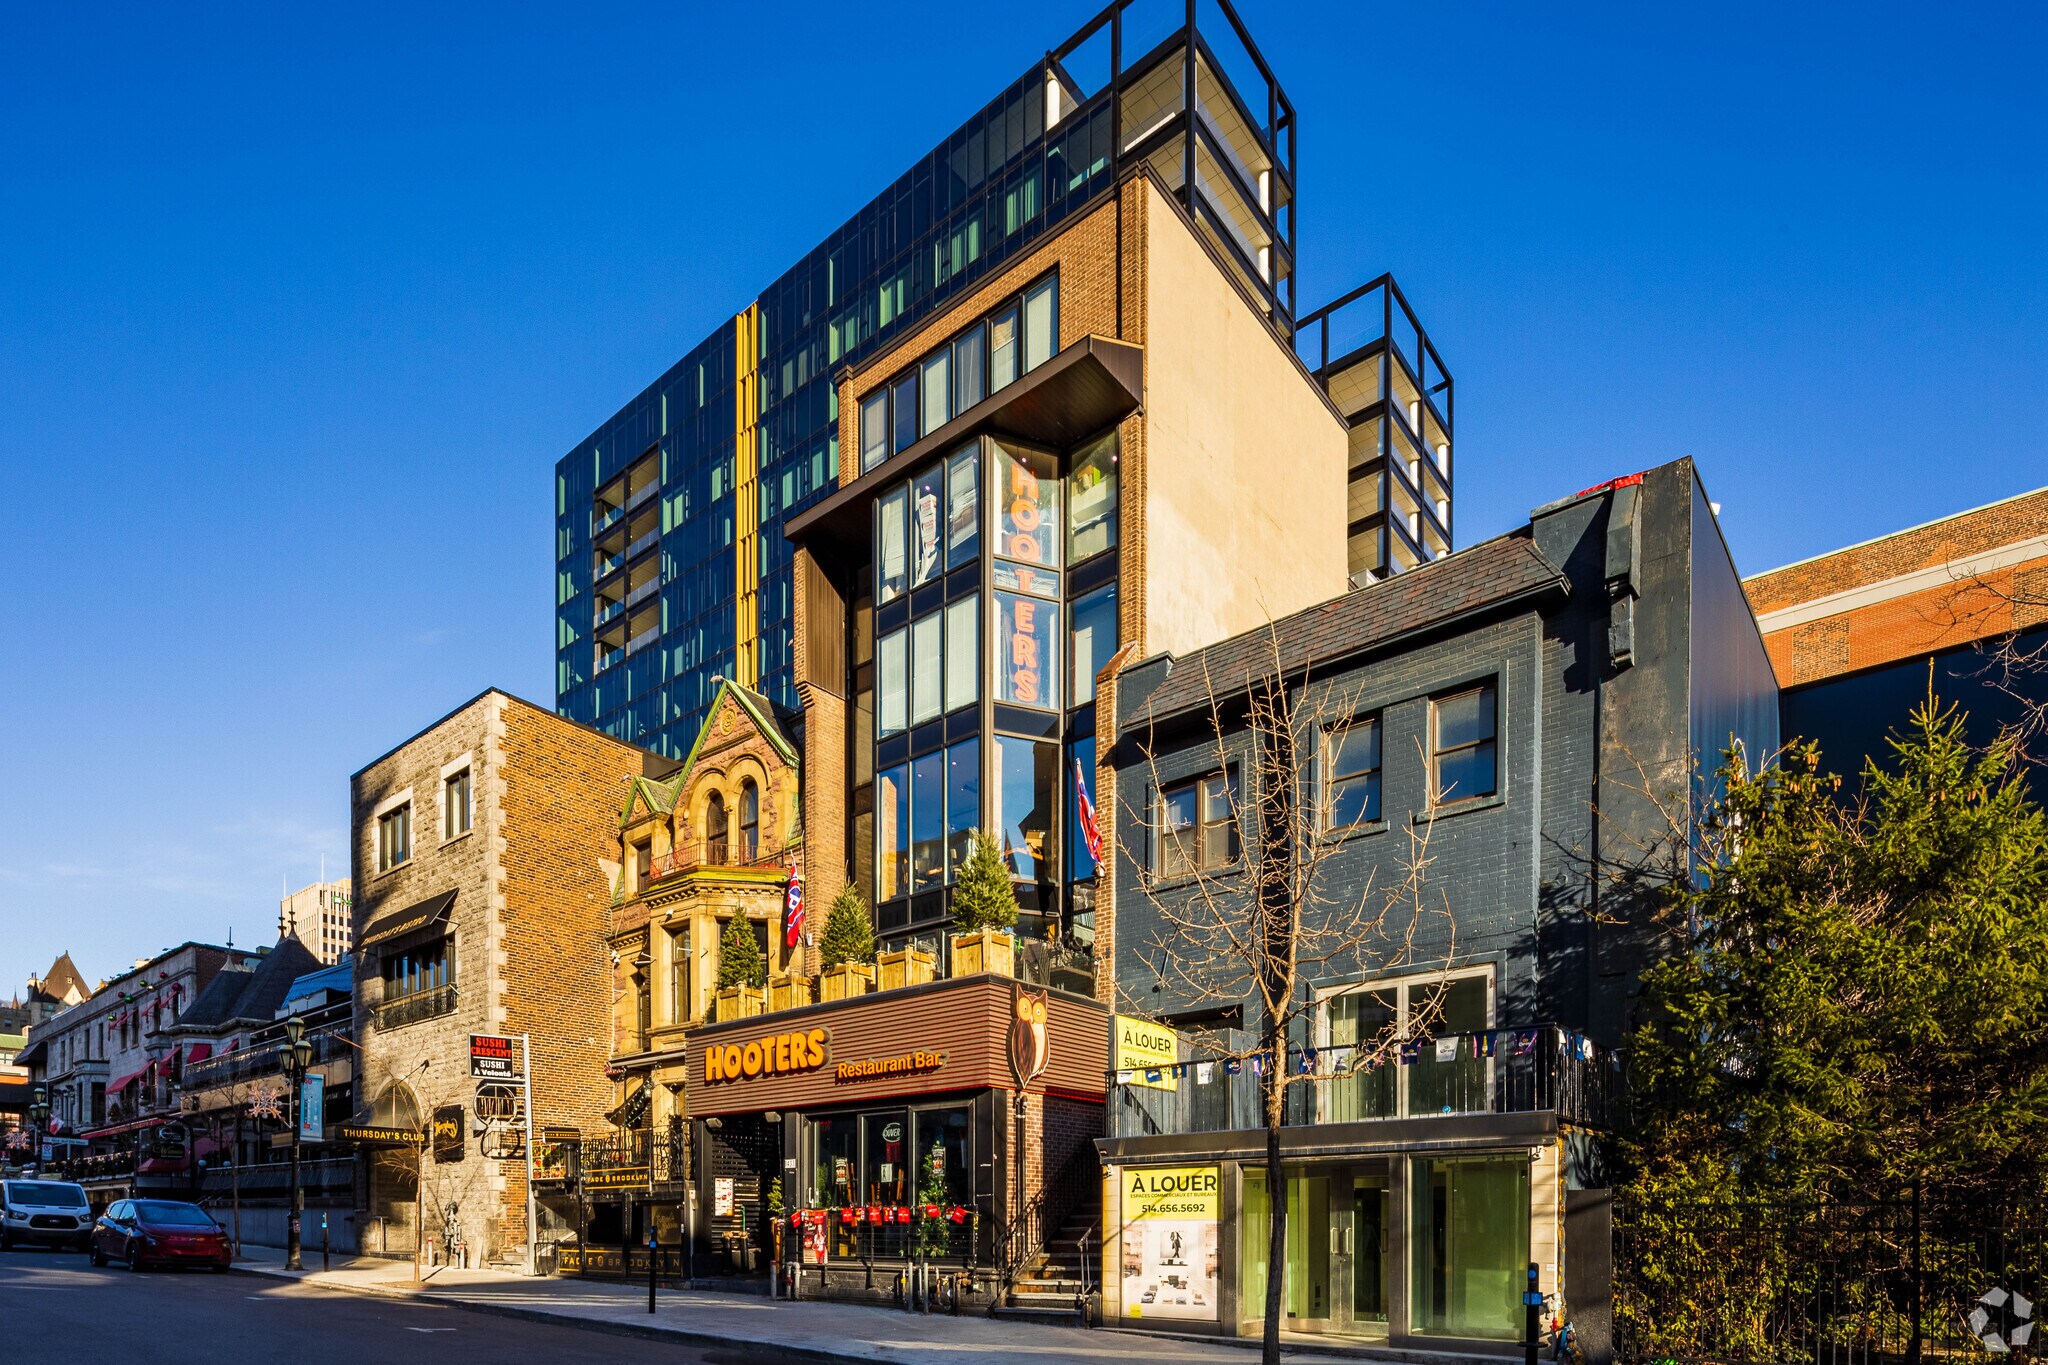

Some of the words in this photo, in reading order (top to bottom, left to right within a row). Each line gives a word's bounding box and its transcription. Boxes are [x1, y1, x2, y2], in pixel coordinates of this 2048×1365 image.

[1010, 462, 1040, 702] HOOTERS
[476, 1037, 507, 1048] SUSHI
[1124, 1026, 1133, 1045] À
[1135, 1032, 1171, 1053] LOUER
[471, 1046, 512, 1058] CRESCENT
[705, 1028, 826, 1081] HOOTERS
[480, 1060, 505, 1069] SUSHI
[838, 1056, 912, 1079] Restaurant
[474, 1067, 480, 1075] À
[481, 1069, 512, 1077] Volonté
[343, 1129, 400, 1140] THURSDAY'S
[402, 1132, 425, 1141] CLUB
[611, 1174, 648, 1182] BROOKLYN
[1131, 1173, 1145, 1193] À
[1151, 1175, 1217, 1192] LOUER
[1142, 1203, 1205, 1213] 514.656.5692
[608, 1258, 680, 1266] BROOKYN
[1375, 1313, 1388, 1322] 14
